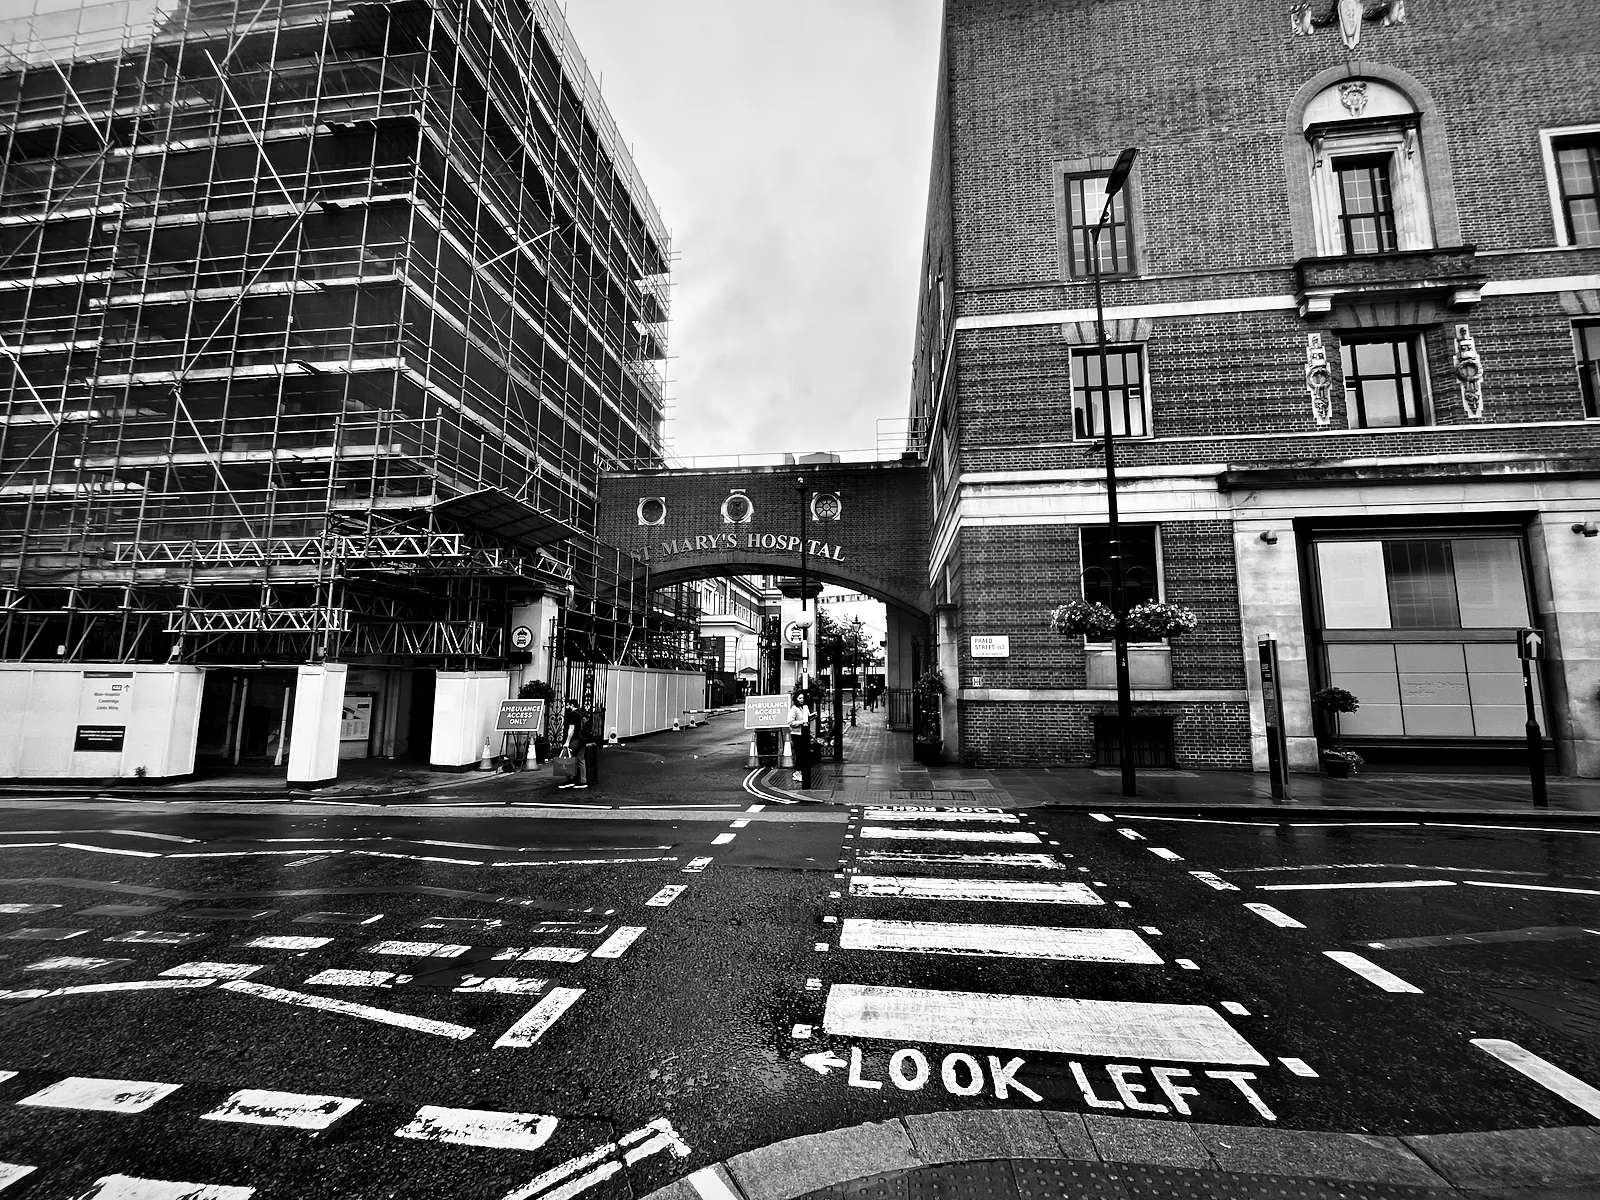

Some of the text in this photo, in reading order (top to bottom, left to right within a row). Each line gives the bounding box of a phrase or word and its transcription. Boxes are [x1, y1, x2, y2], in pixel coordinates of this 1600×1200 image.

[661, 533, 738, 557] MARY'S
[747, 701, 788, 709] AMBULANCE
[943, 806, 1004, 814] LOOK
[848, 1046, 1277, 1120] LOOK LEFT
